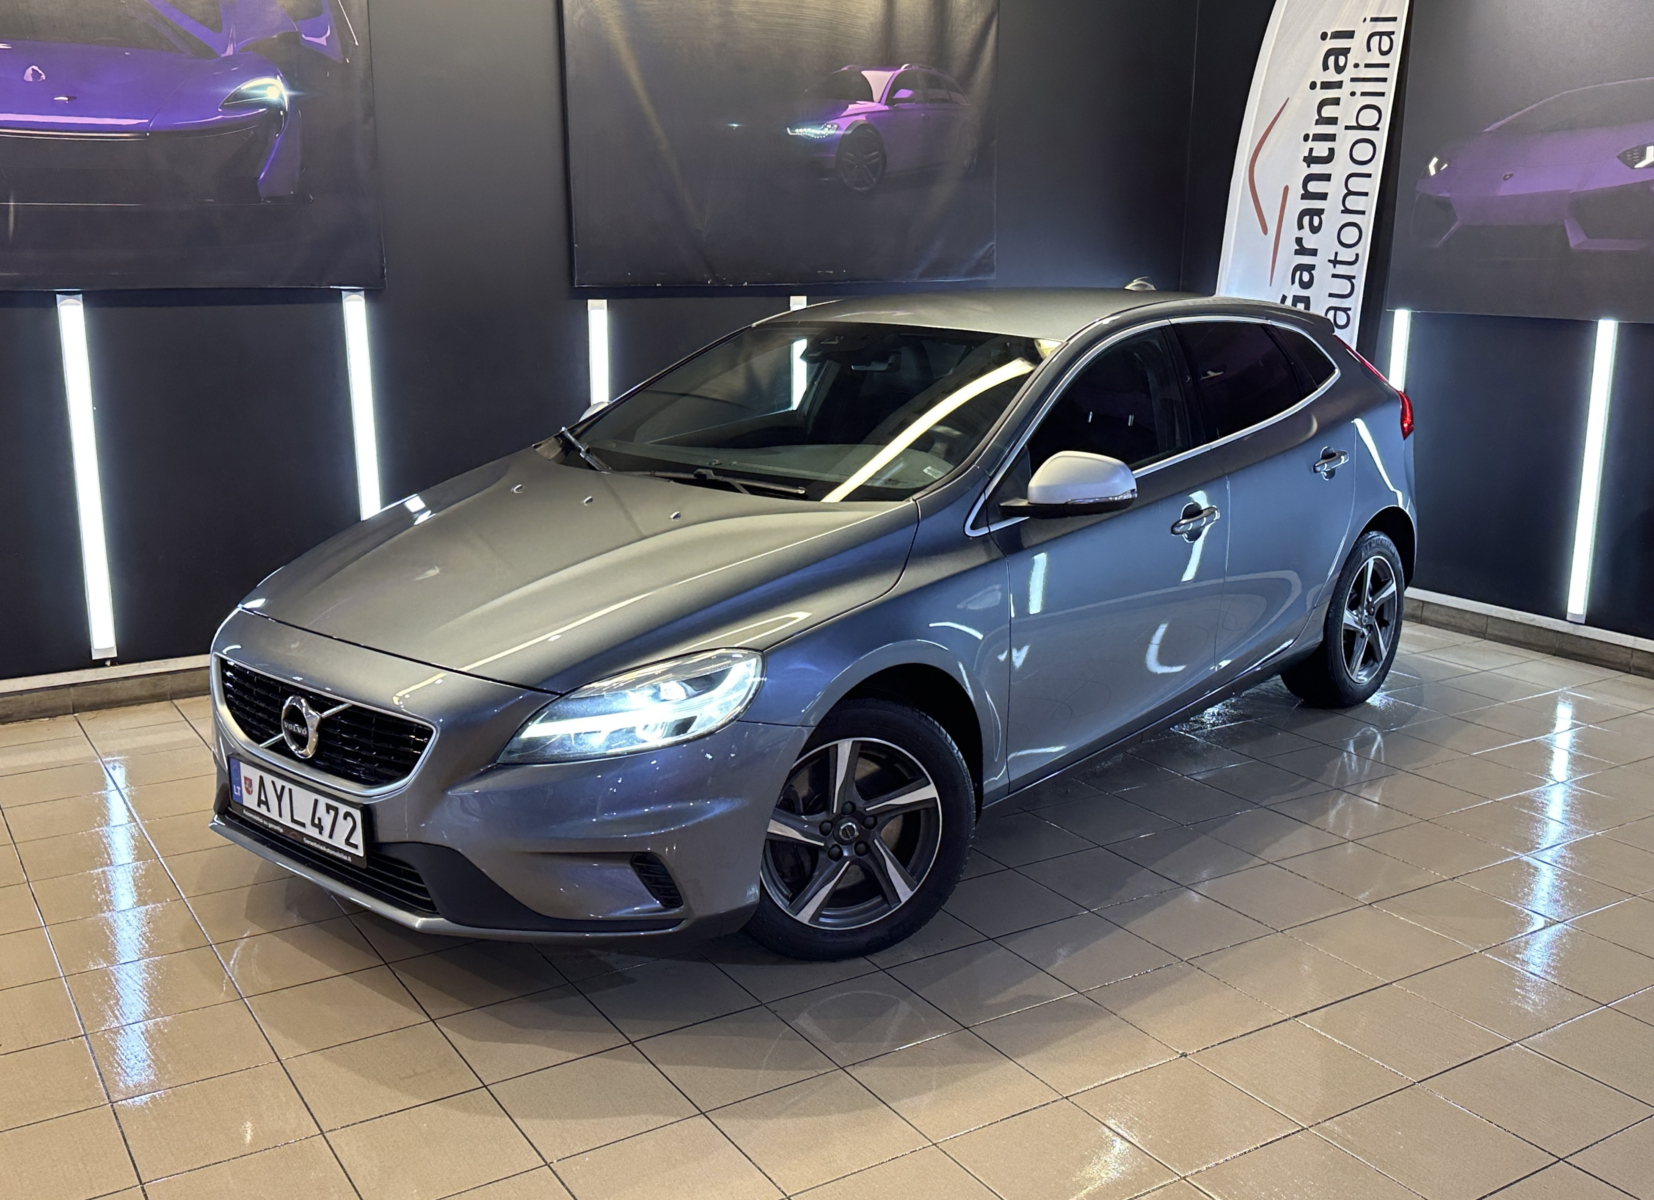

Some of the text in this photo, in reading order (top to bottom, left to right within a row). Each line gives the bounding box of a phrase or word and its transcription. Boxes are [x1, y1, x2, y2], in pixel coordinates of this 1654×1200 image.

[1324, 15, 1398, 330] automobiliai
[283, 720, 308, 735] VOLVO
[234, 784, 242, 796] LT
